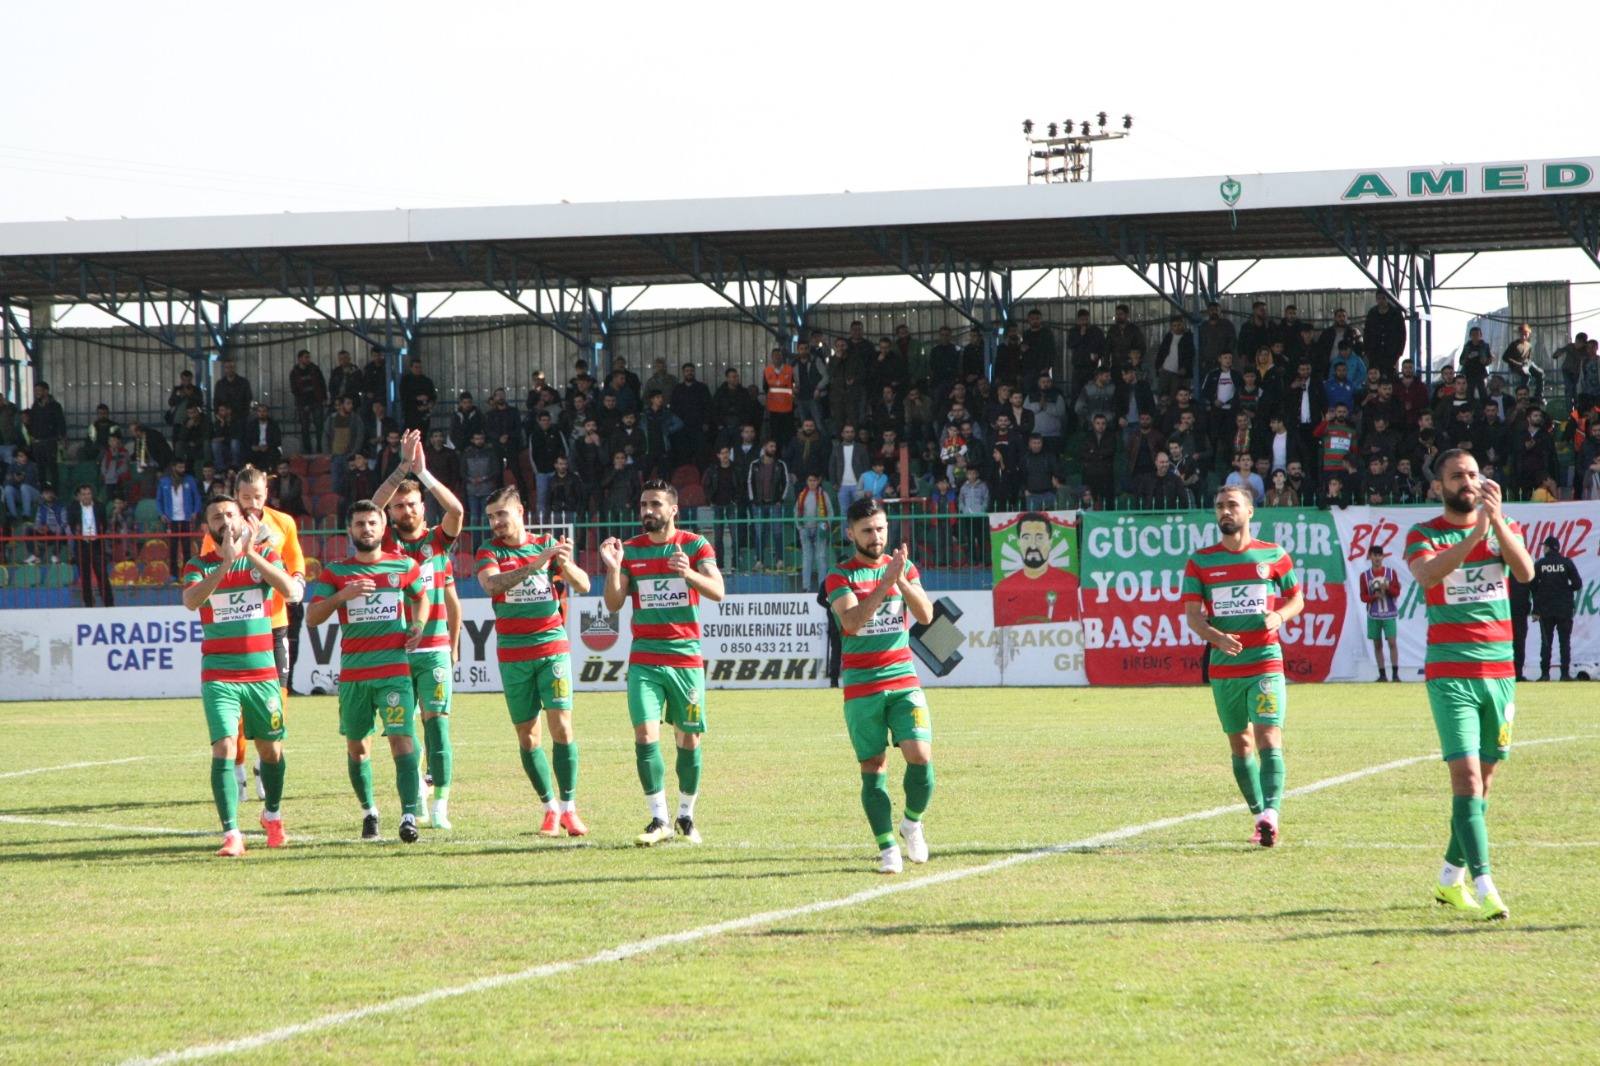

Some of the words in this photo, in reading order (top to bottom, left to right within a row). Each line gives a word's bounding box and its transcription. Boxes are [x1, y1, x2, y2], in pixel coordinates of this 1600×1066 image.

[1088, 516, 1262, 558] GÜCÜM
[1090, 570, 1185, 603] YOLU
[640, 592, 687, 602] CENKAR
[1214, 600, 1265, 609] CENKAR
[214, 603, 262, 616] CENKAR
[348, 605, 397, 616] CENKAR
[720, 643, 728, 653] 0
[730, 642, 752, 653] 850
[754, 642, 776, 653] 433
[779, 642, 793, 653] 21
[796, 642, 810, 653] 21
[107, 648, 173, 671] CAFE
[469, 666, 490, 687] Şti.
[434, 683, 444, 699] 4
[552, 679, 569, 698] 19
[1256, 694, 1277, 714] 23
[386, 706, 405, 723] 22
